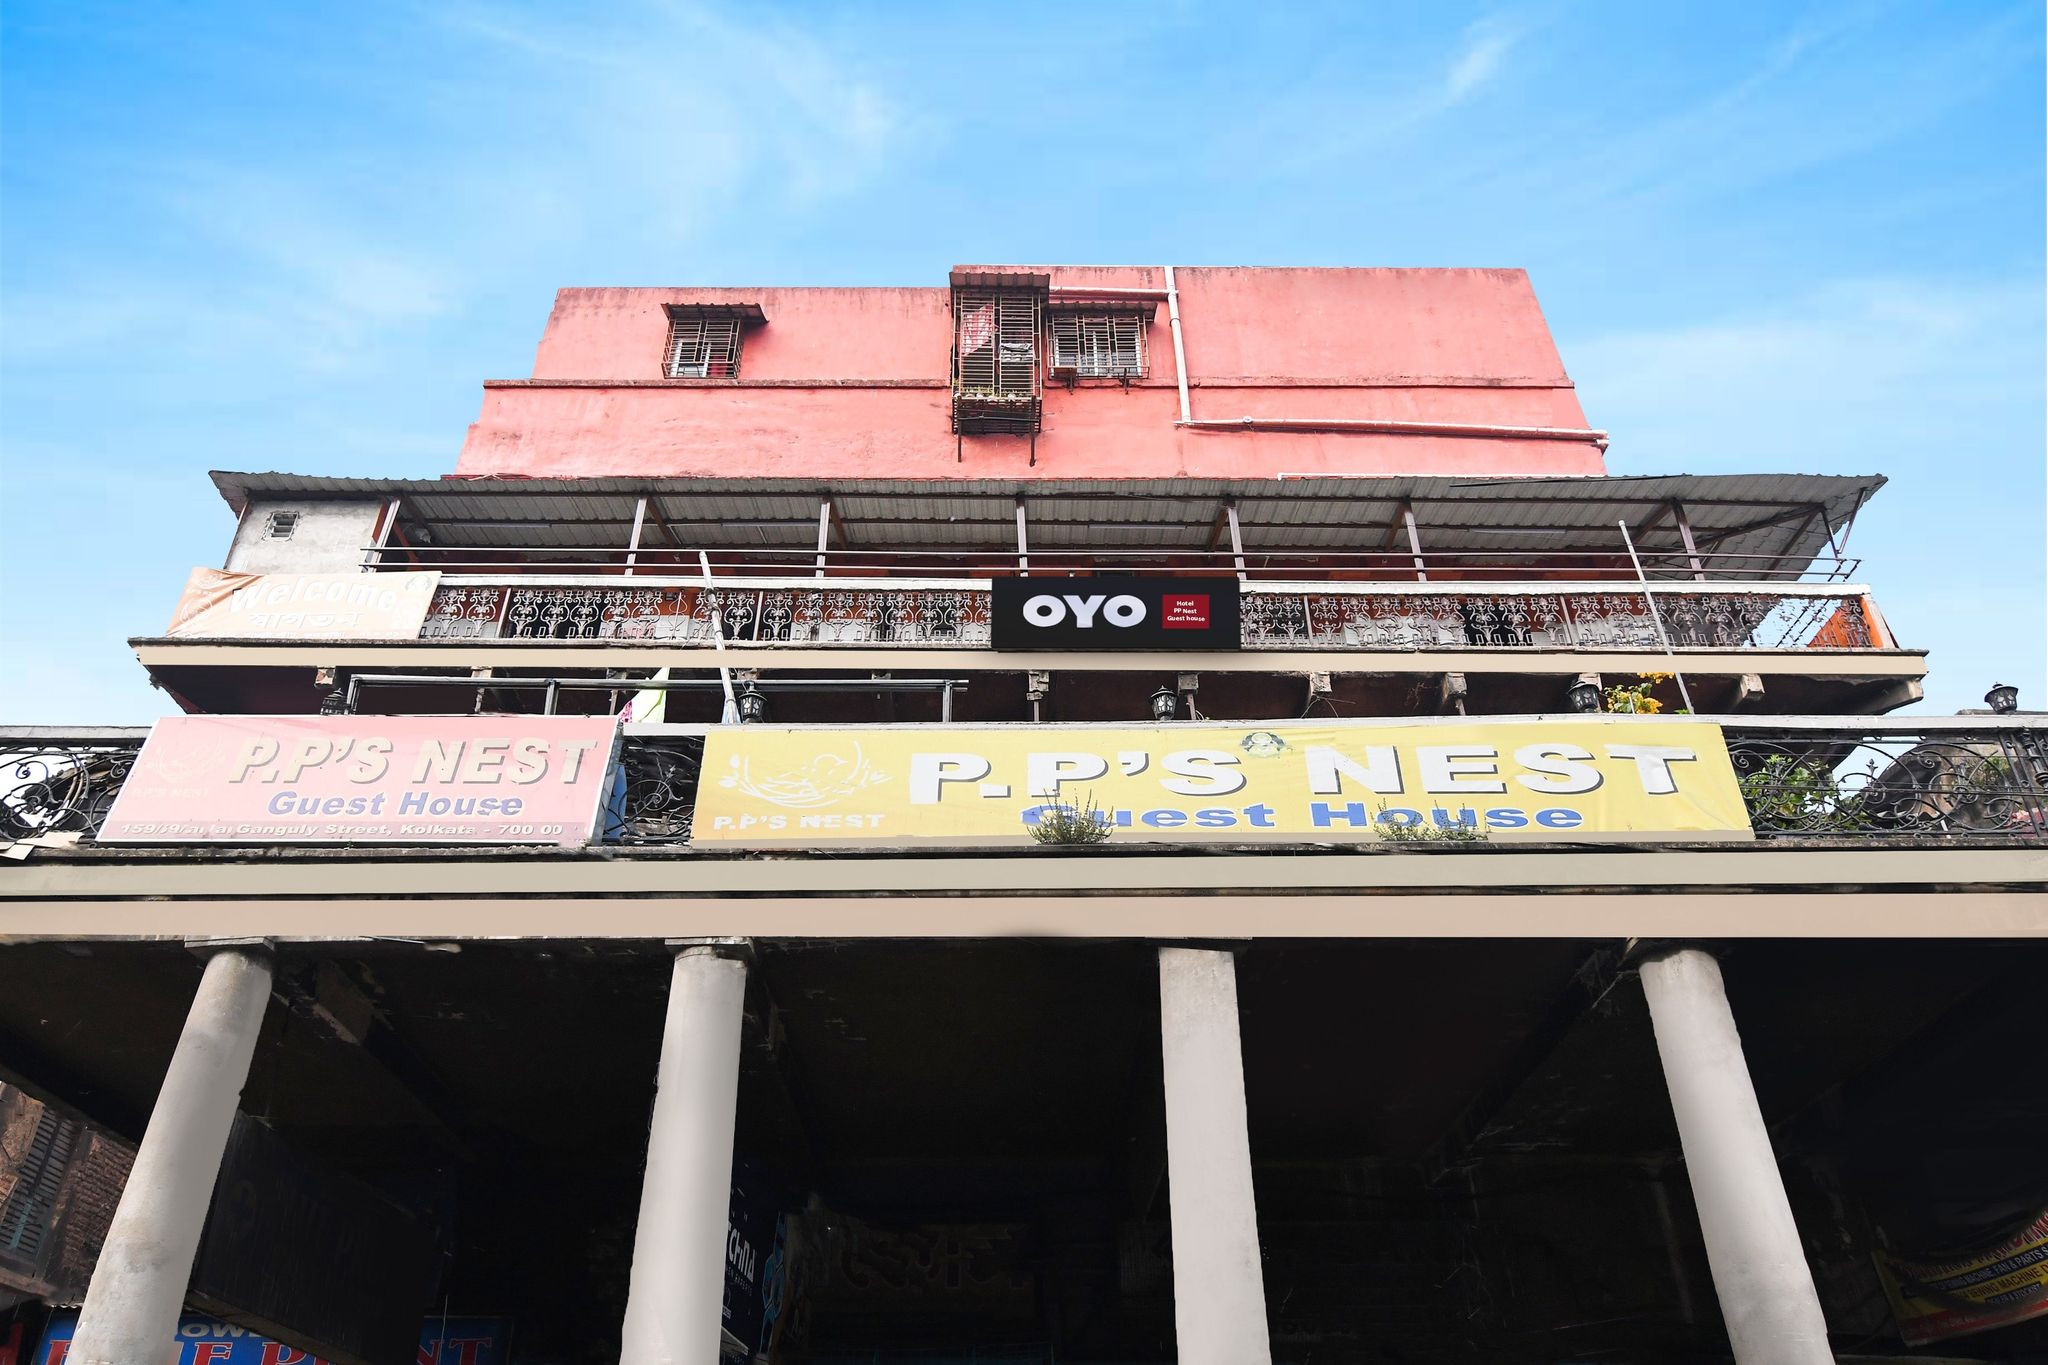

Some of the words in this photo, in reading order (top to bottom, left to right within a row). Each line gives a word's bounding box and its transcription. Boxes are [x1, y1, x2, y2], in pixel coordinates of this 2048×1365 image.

[228, 575, 398, 613] Welcome
[1022, 594, 1147, 628] OYO
[228, 735, 395, 785] P.P'S
[411, 736, 599, 785] NEST
[909, 749, 1247, 805] P.P'S
[1304, 743, 1698, 795] NEST
[267, 791, 386, 817] Guest
[397, 792, 524, 817] House
[1309, 802, 1584, 830] House
[236, 822, 319, 838] Ganguly
[323, 821, 394, 836] Street,
[496, 824, 536, 836] 700
[713, 813, 788, 830] P.P'S
[799, 814, 887, 830] NEST
